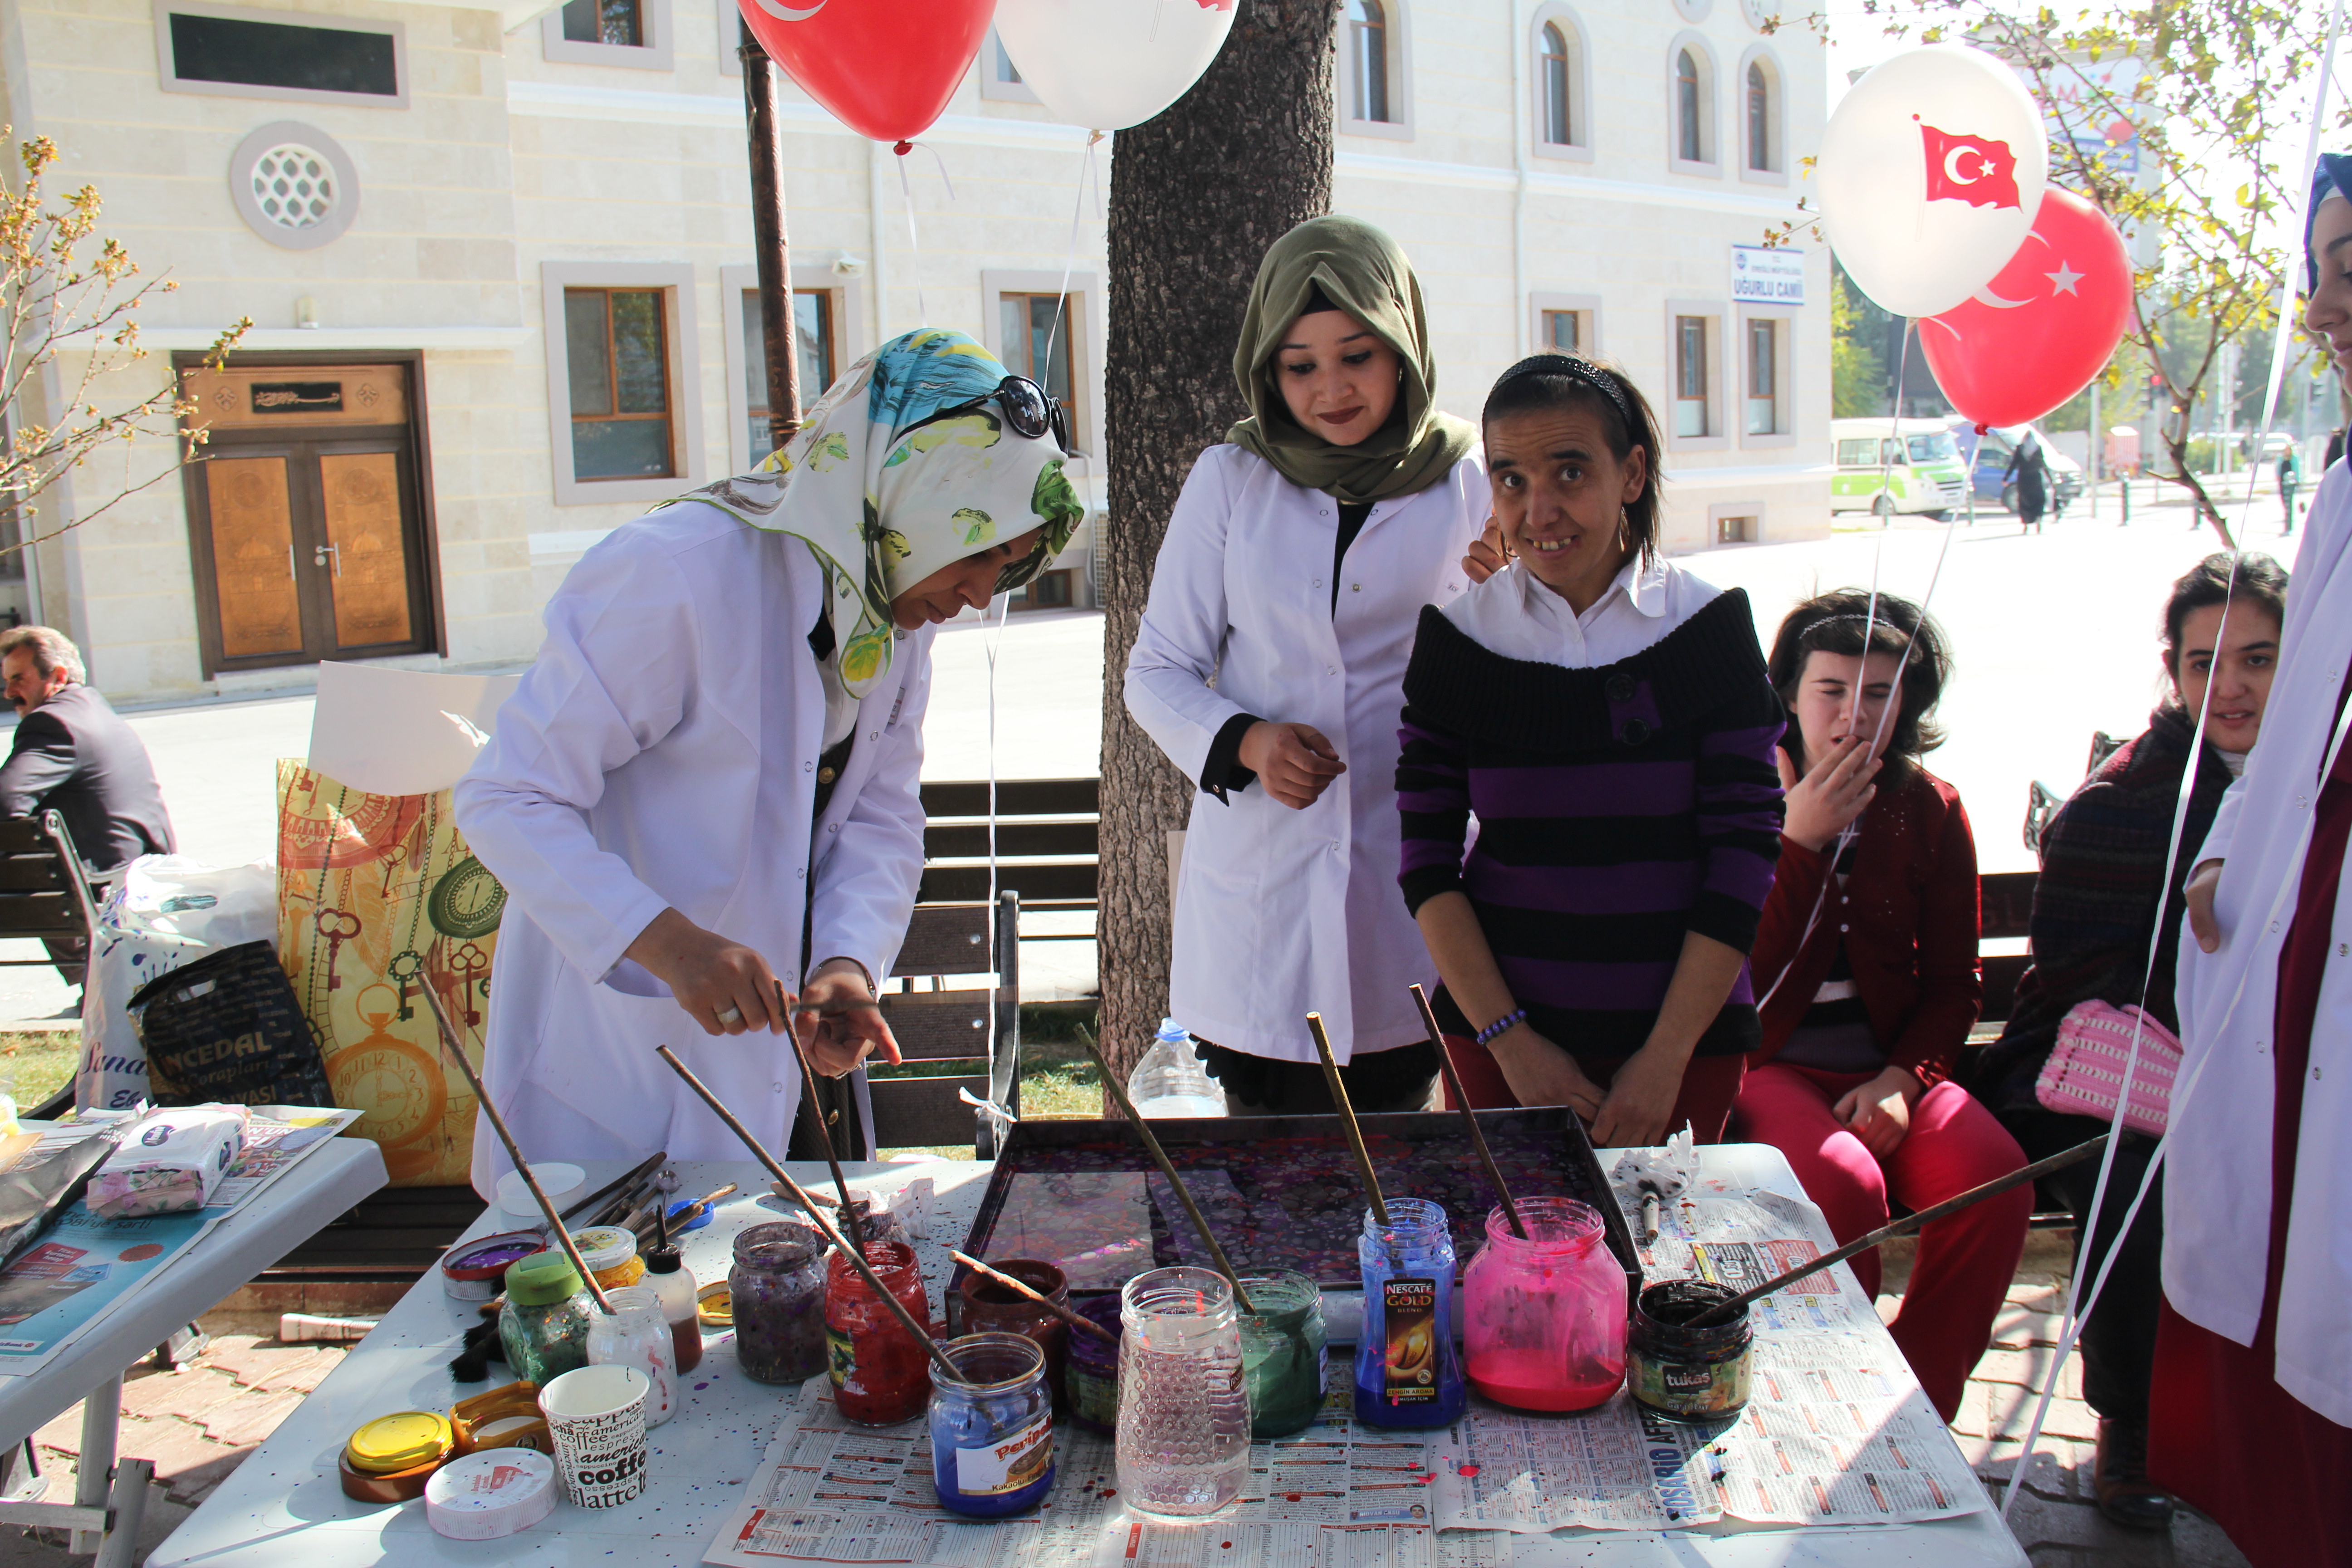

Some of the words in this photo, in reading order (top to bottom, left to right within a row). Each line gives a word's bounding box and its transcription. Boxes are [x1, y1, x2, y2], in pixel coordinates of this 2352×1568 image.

[1734, 276, 1774, 296] UĞURLU
[80, 1041, 148, 1076] Sana
[354, 1058, 365, 1072] 11
[374, 1052, 385, 1065] 12
[397, 1056, 401, 1069] 1
[340, 1073, 351, 1086] 10
[409, 1069, 416, 1083] 2
[336, 1091, 345, 1105] 9
[415, 1088, 423, 1101] 3
[410, 1107, 419, 1120] 4
[358, 1122, 365, 1132] 7
[378, 1126, 385, 1138] 6
[398, 1121, 404, 1132] 5
[1387, 1284, 1432, 1294] NESCAFÉ
[1387, 1295, 1431, 1306] GOLD
[591, 1408, 646, 1436] american
[560, 1431, 608, 1450] coffee
[590, 1426, 643, 1451] espresso
[576, 1461, 617, 1469] cappuccino
[578, 1449, 646, 1485] coffe
[992, 1477, 1025, 1492] Kakaolu
[577, 1484, 637, 1509] latte
